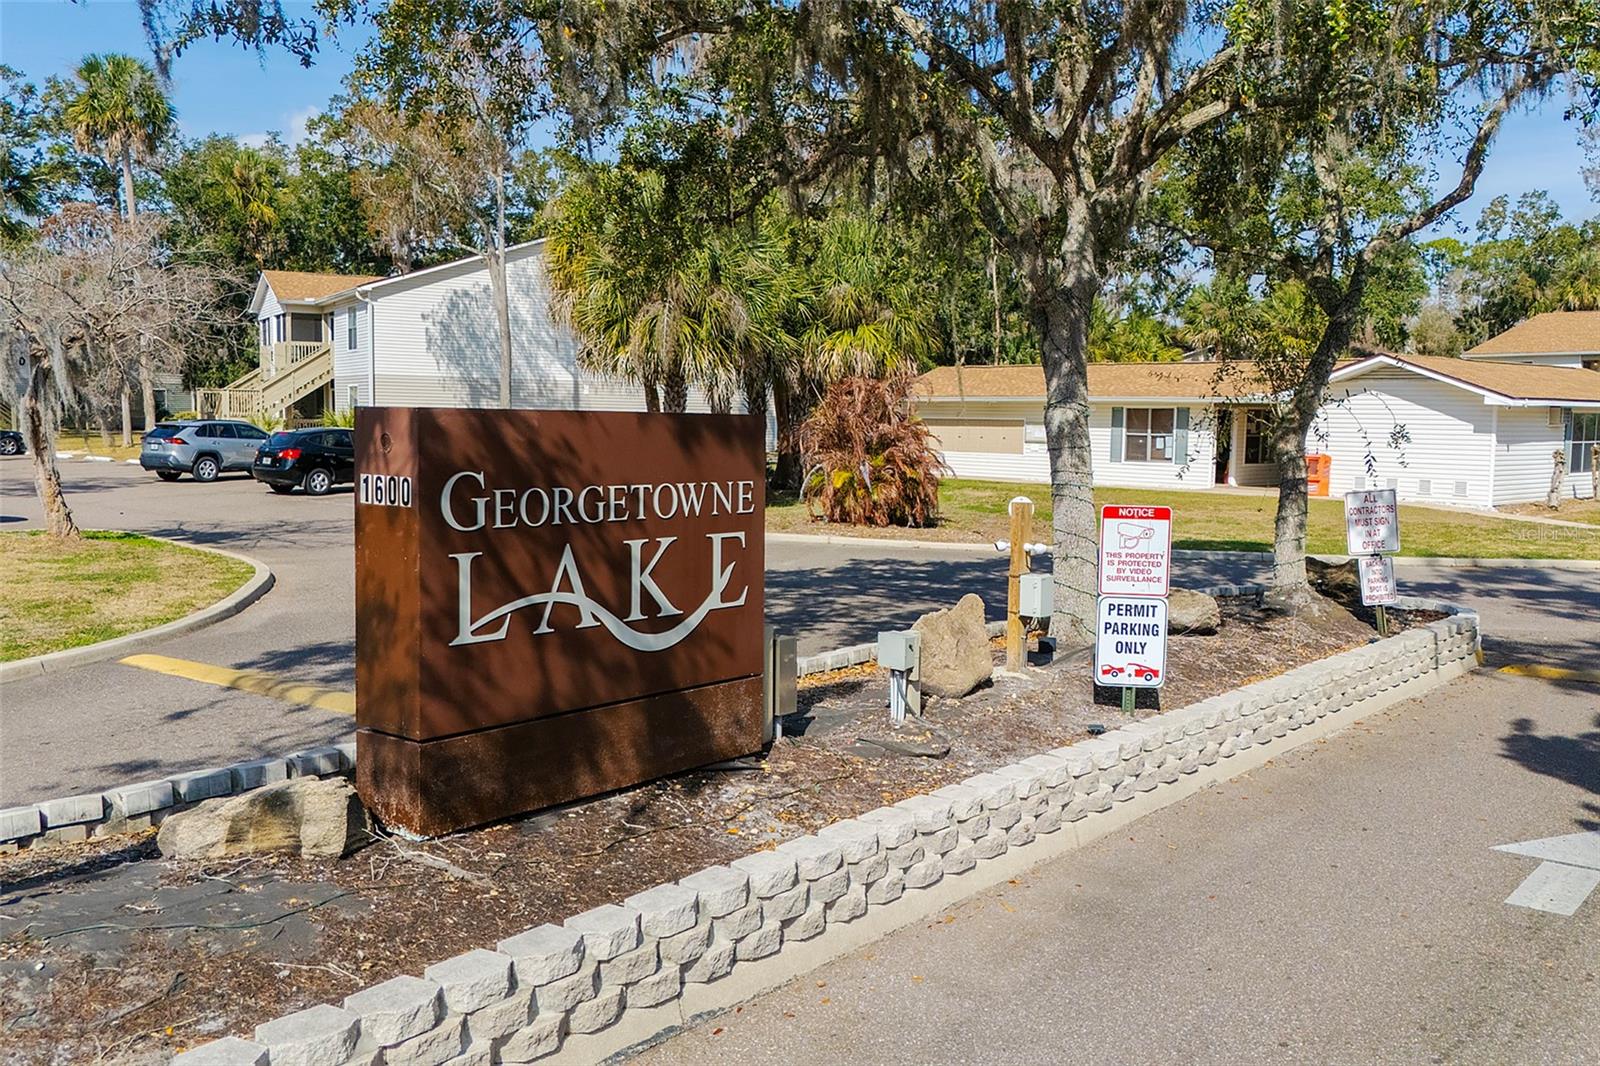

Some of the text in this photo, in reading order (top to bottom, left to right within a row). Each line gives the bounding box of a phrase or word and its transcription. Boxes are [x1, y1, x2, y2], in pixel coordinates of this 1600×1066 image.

[362, 475, 410, 506] 1600
[440, 471, 755, 532] GEORGETOWNE
[1364, 495, 1378, 503] ALL
[1118, 508, 1155, 517] NOTICE
[1349, 504, 1395, 516] CONTRACTORS
[1355, 516, 1390, 527] MUST SIGN
[1362, 540, 1385, 550] OFFICE
[1106, 551, 1165, 560] THIS PROPERTY
[1117, 560, 1162, 568] PROTECTED
[1116, 567, 1126, 575] BY
[1106, 575, 1162, 584] SURVEILLANCE
[448, 531, 749, 652] LAKE
[1108, 603, 1158, 618] PERMIT
[1104, 622, 1160, 637] PARKING
[1115, 641, 1147, 655] ONLY
